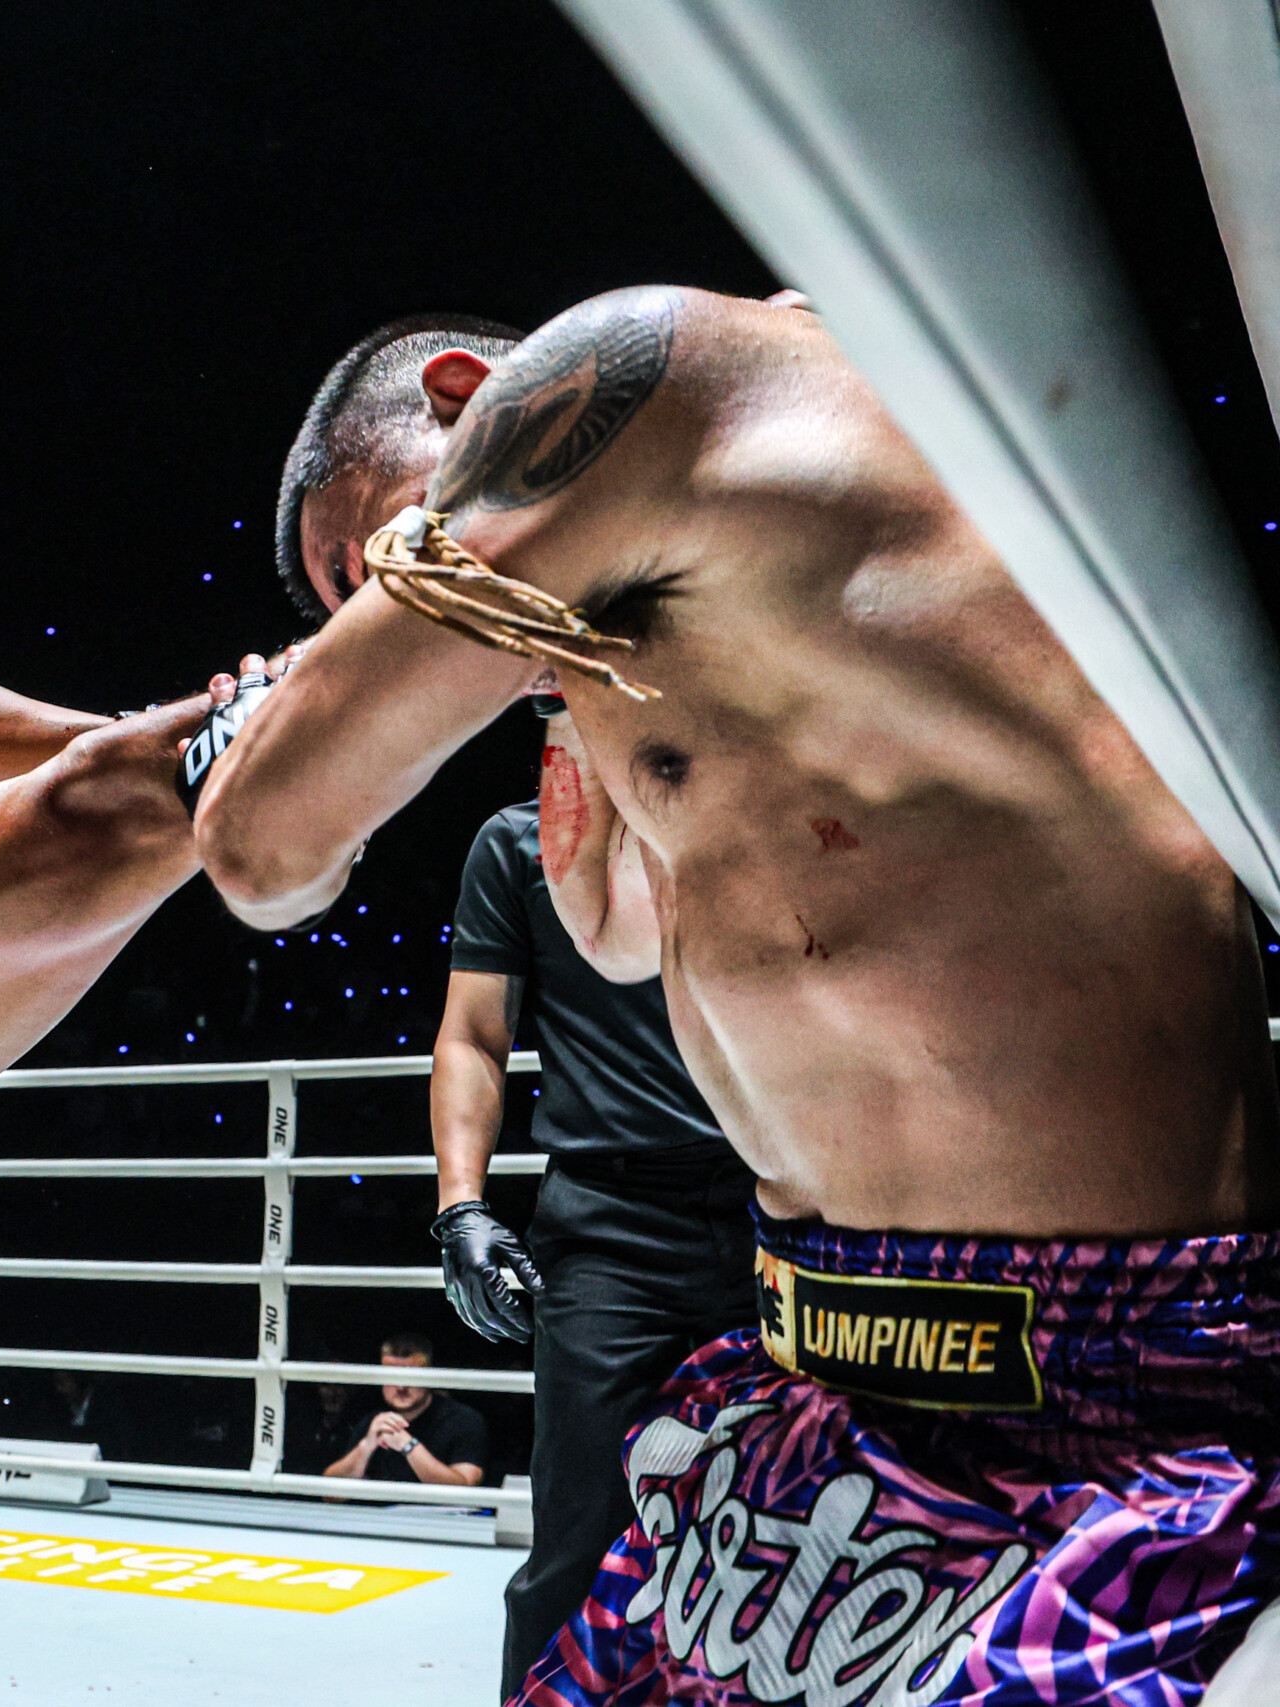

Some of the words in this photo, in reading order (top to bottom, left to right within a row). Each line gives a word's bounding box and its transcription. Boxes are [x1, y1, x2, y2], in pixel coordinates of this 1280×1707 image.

[185, 703, 248, 787] ON
[272, 1107, 288, 1146] ONE
[268, 1204, 283, 1245] ONE
[263, 1304, 279, 1345] ONE
[803, 1304, 1001, 1373] LUMPINEE
[260, 1405, 275, 1447] ONE
